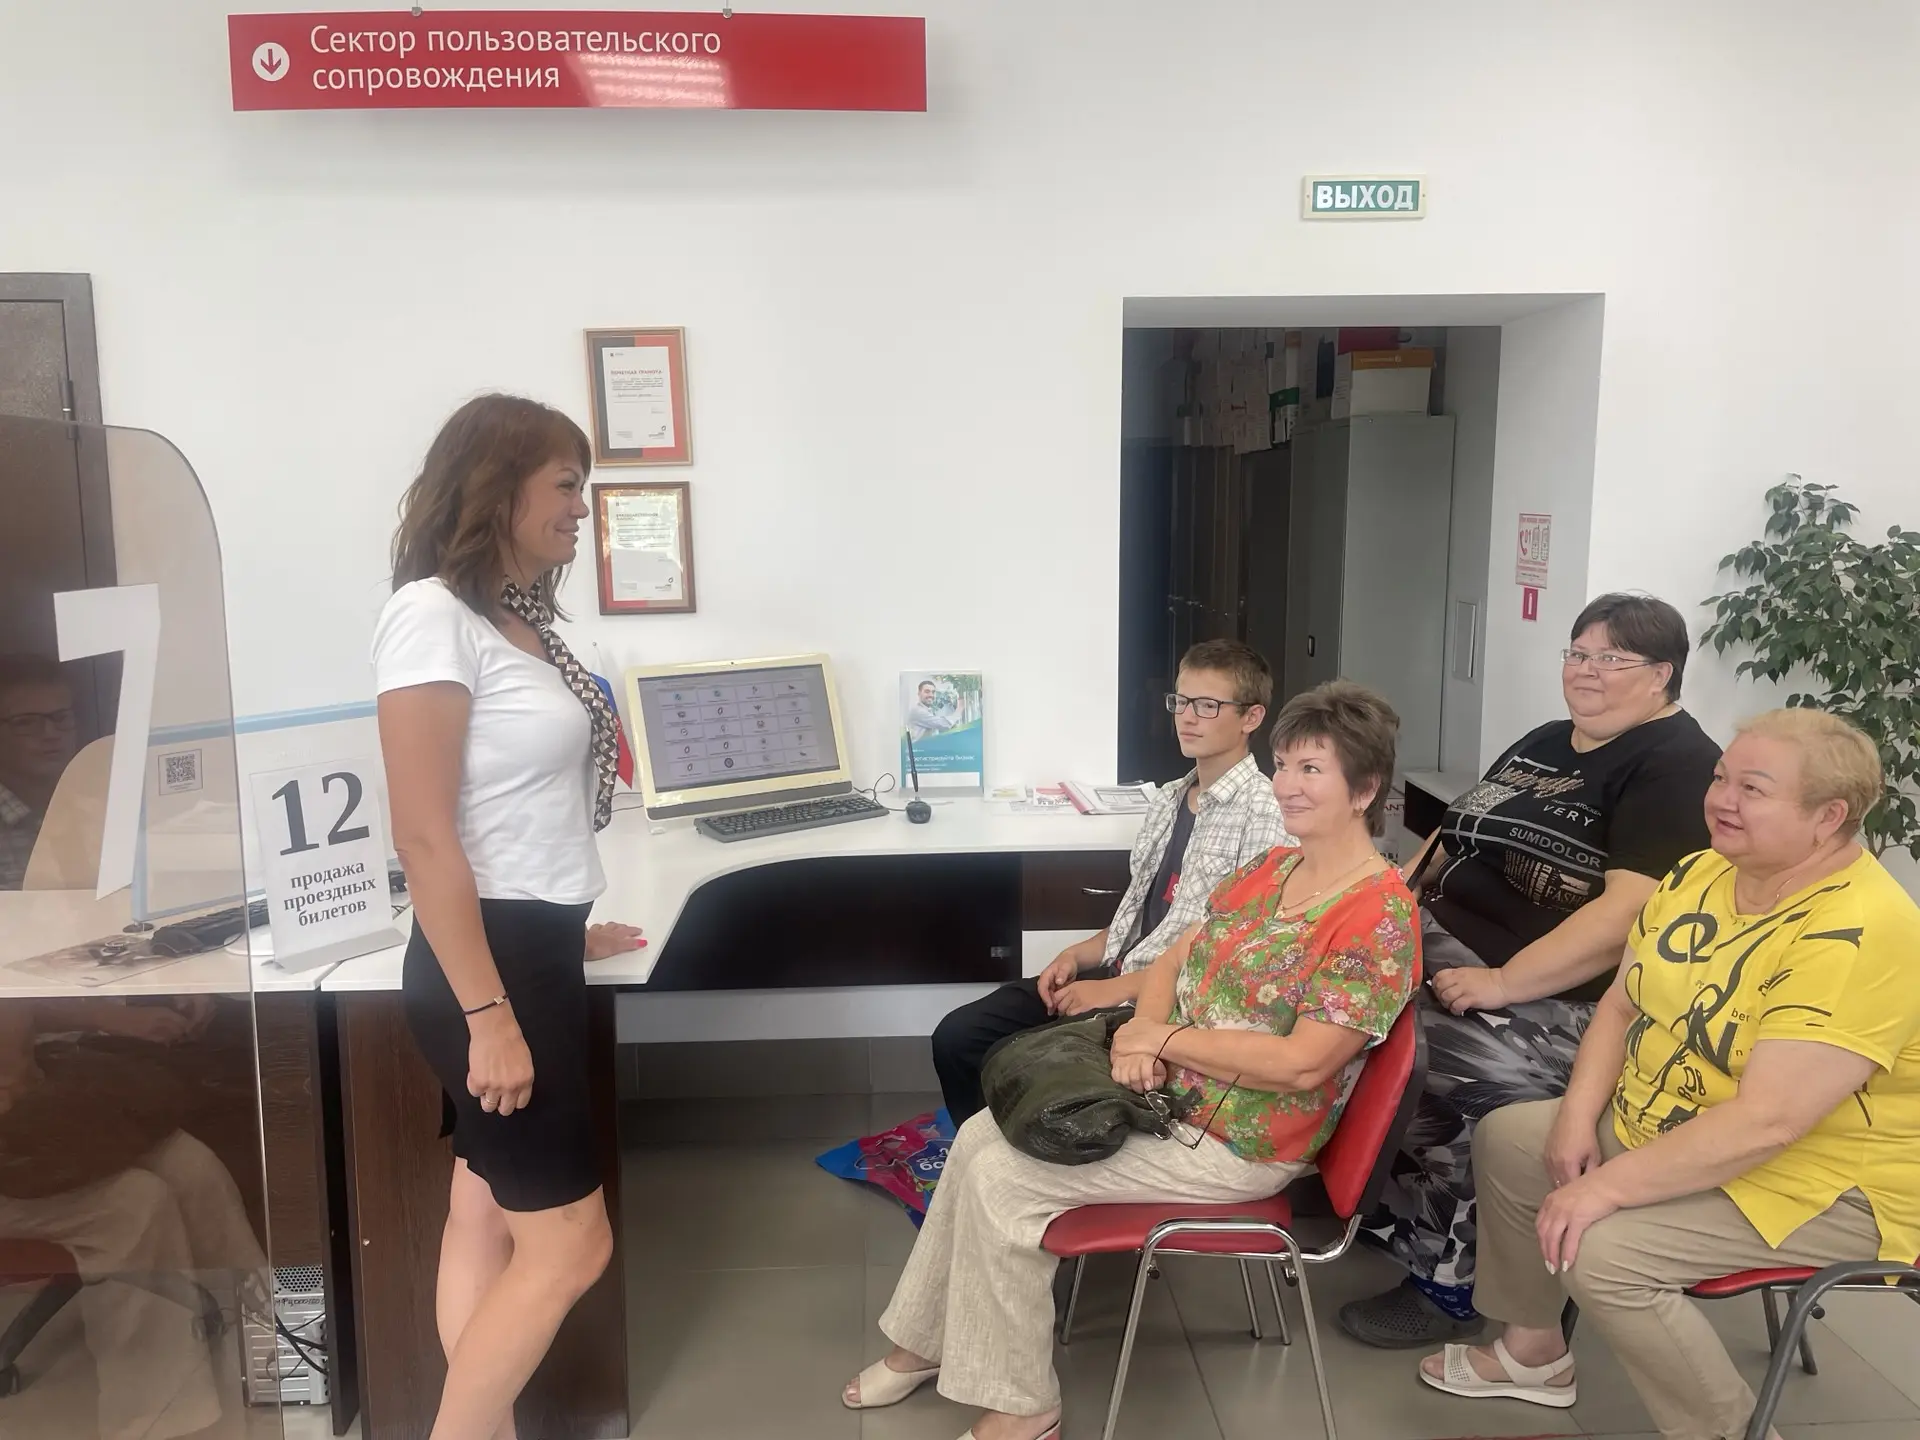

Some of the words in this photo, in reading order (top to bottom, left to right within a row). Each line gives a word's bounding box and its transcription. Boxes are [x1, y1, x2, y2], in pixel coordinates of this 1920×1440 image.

[310, 24, 416, 58] Сектор
[428, 29, 721, 54] пользовательского
[312, 66, 561, 96] сопровождения
[1316, 184, 1414, 210] ВЫХОД
[53, 583, 161, 901] 7
[271, 771, 370, 856] 12
[1543, 804, 1595, 827] VERY
[1509, 827, 1601, 868] SUMDOLOR
[291, 861, 365, 890] продажа
[284, 878, 377, 912] проездных
[298, 900, 367, 926] билетов
